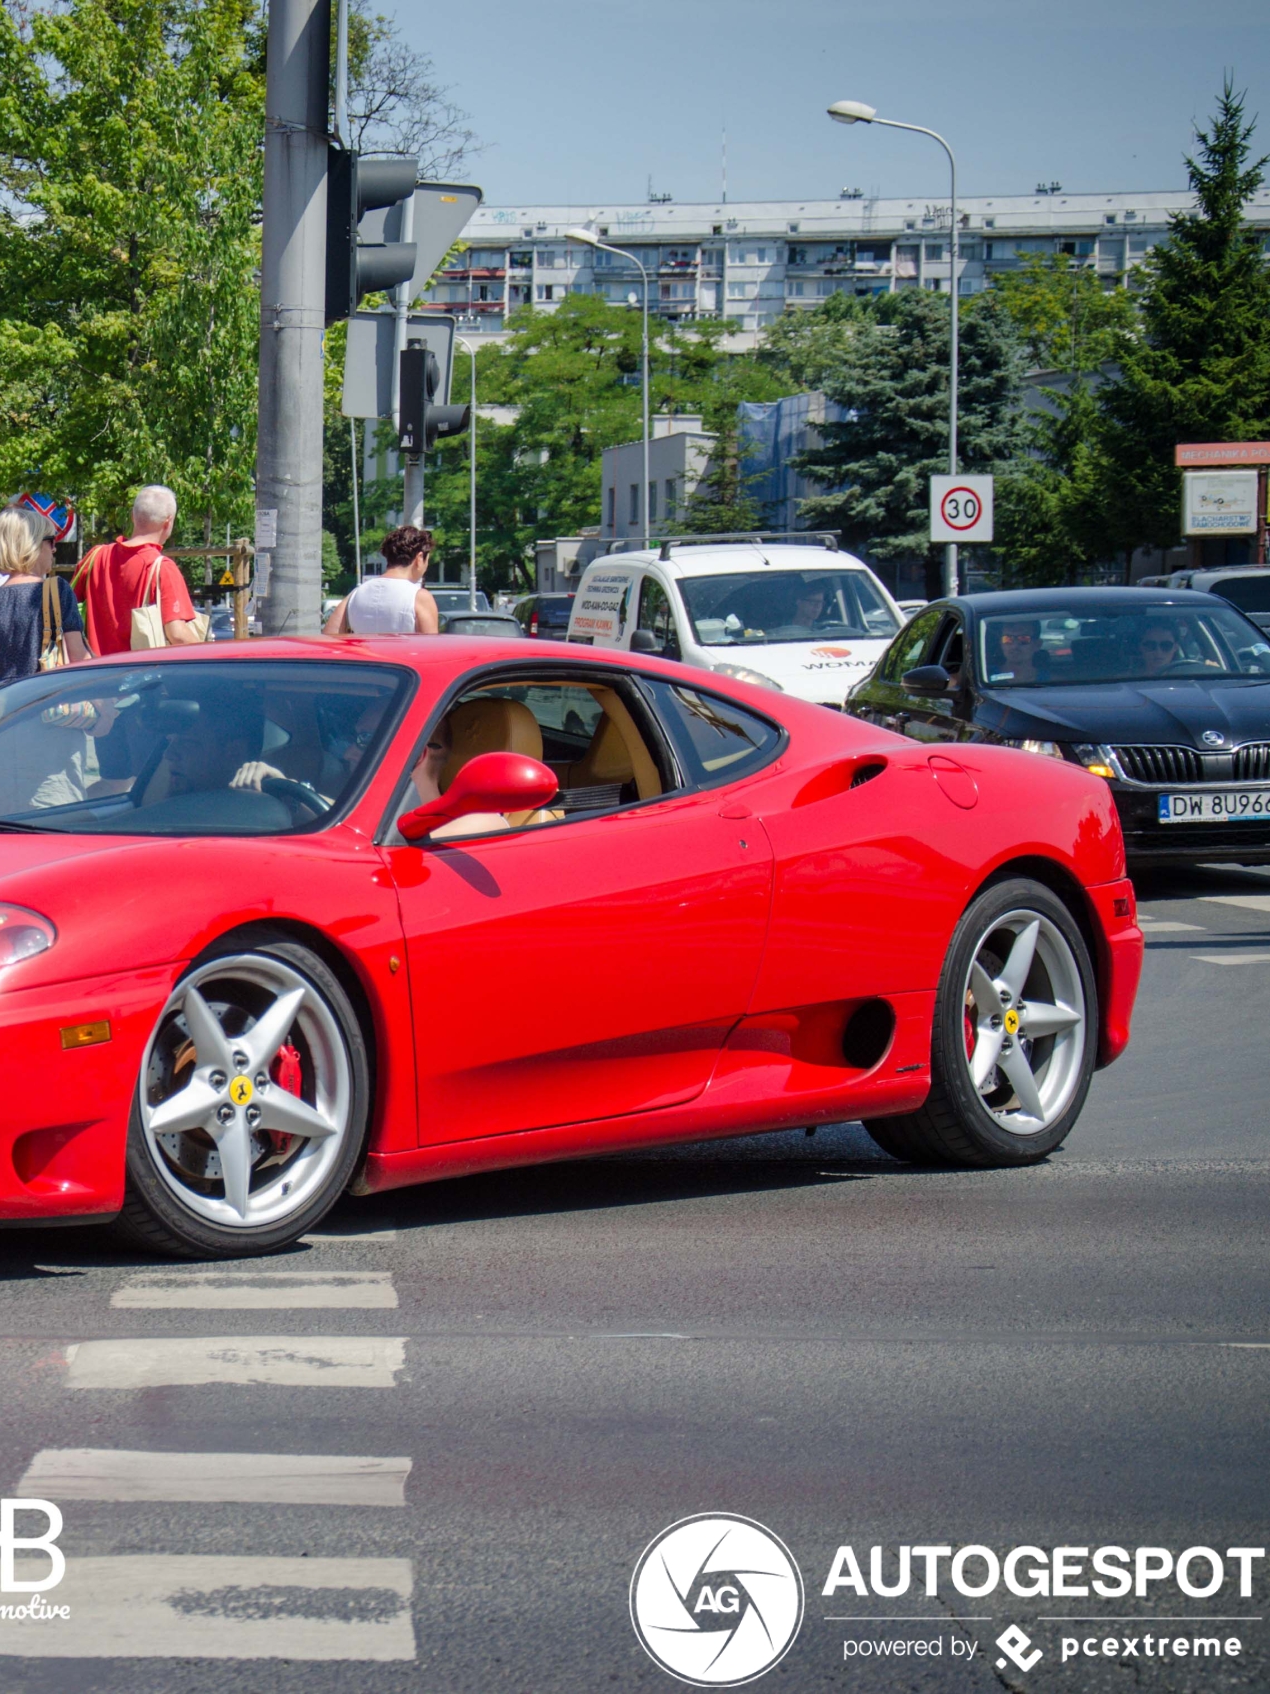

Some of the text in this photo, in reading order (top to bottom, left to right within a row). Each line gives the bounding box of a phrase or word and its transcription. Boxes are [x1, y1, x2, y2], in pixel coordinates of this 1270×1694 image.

[1181, 448, 1249, 459] MECHANIKA
[948, 498, 976, 519] 30
[1173, 796, 1202, 816] DW
